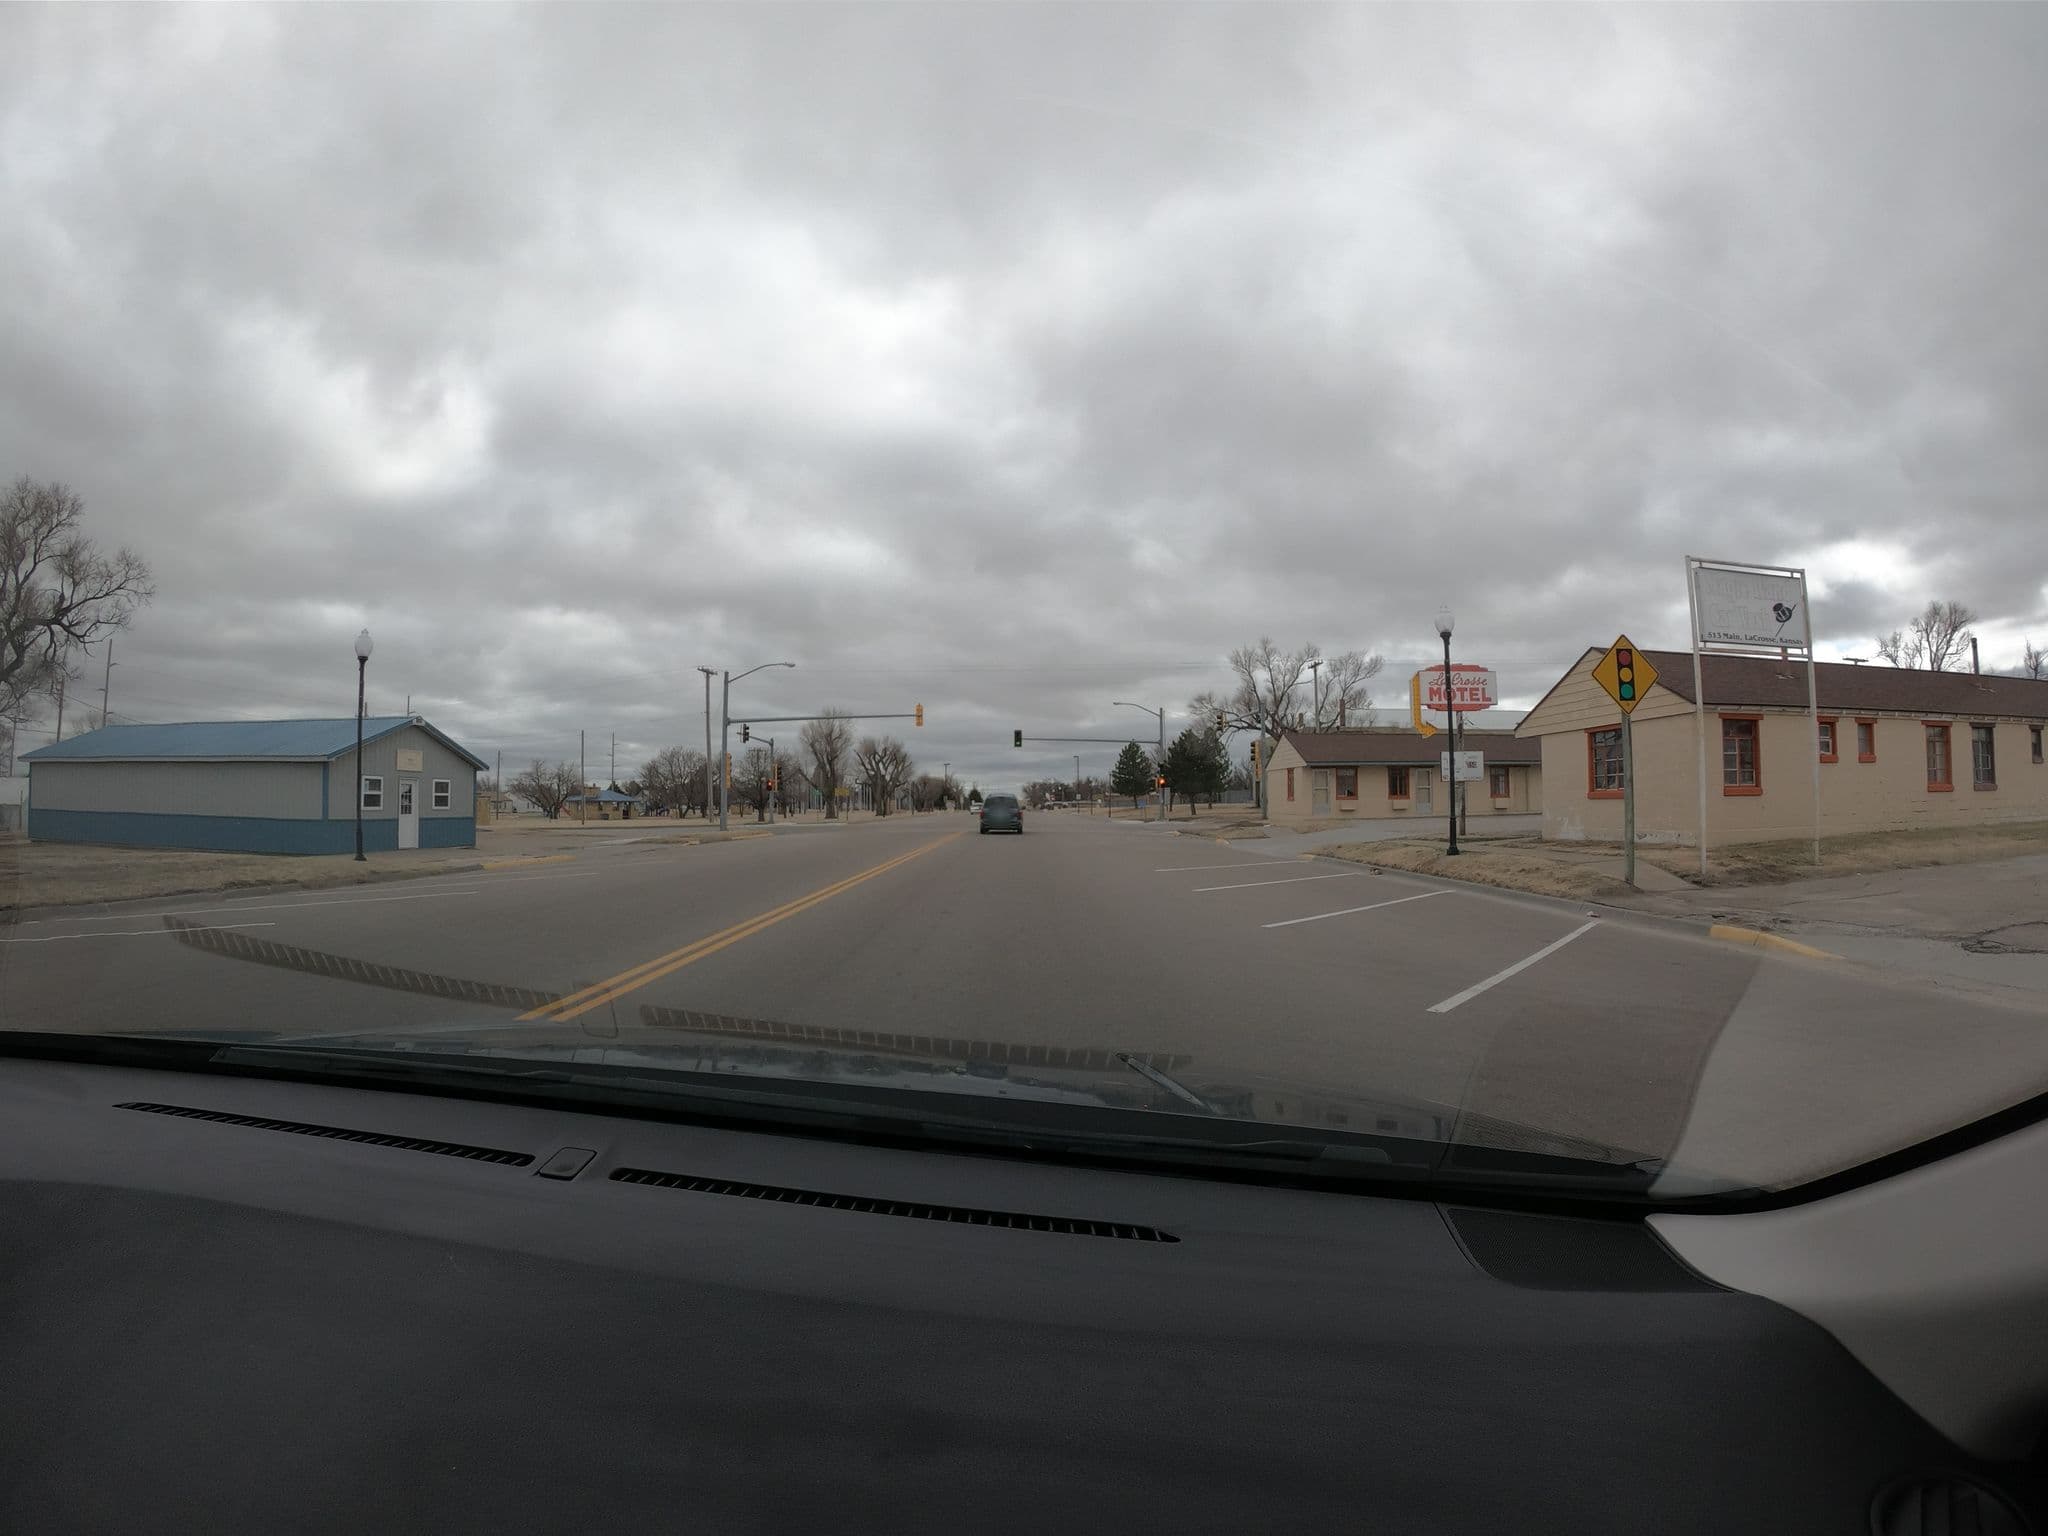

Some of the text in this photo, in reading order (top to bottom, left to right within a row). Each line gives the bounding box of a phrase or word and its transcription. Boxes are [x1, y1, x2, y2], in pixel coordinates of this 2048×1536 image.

[1707, 631, 1721, 639] 513
[1723, 633, 1742, 641] Main,
[1780, 636, 1803, 645] Kansas
[1452, 672, 1488, 686] Crosse
[1429, 687, 1492, 702] MOTEL
